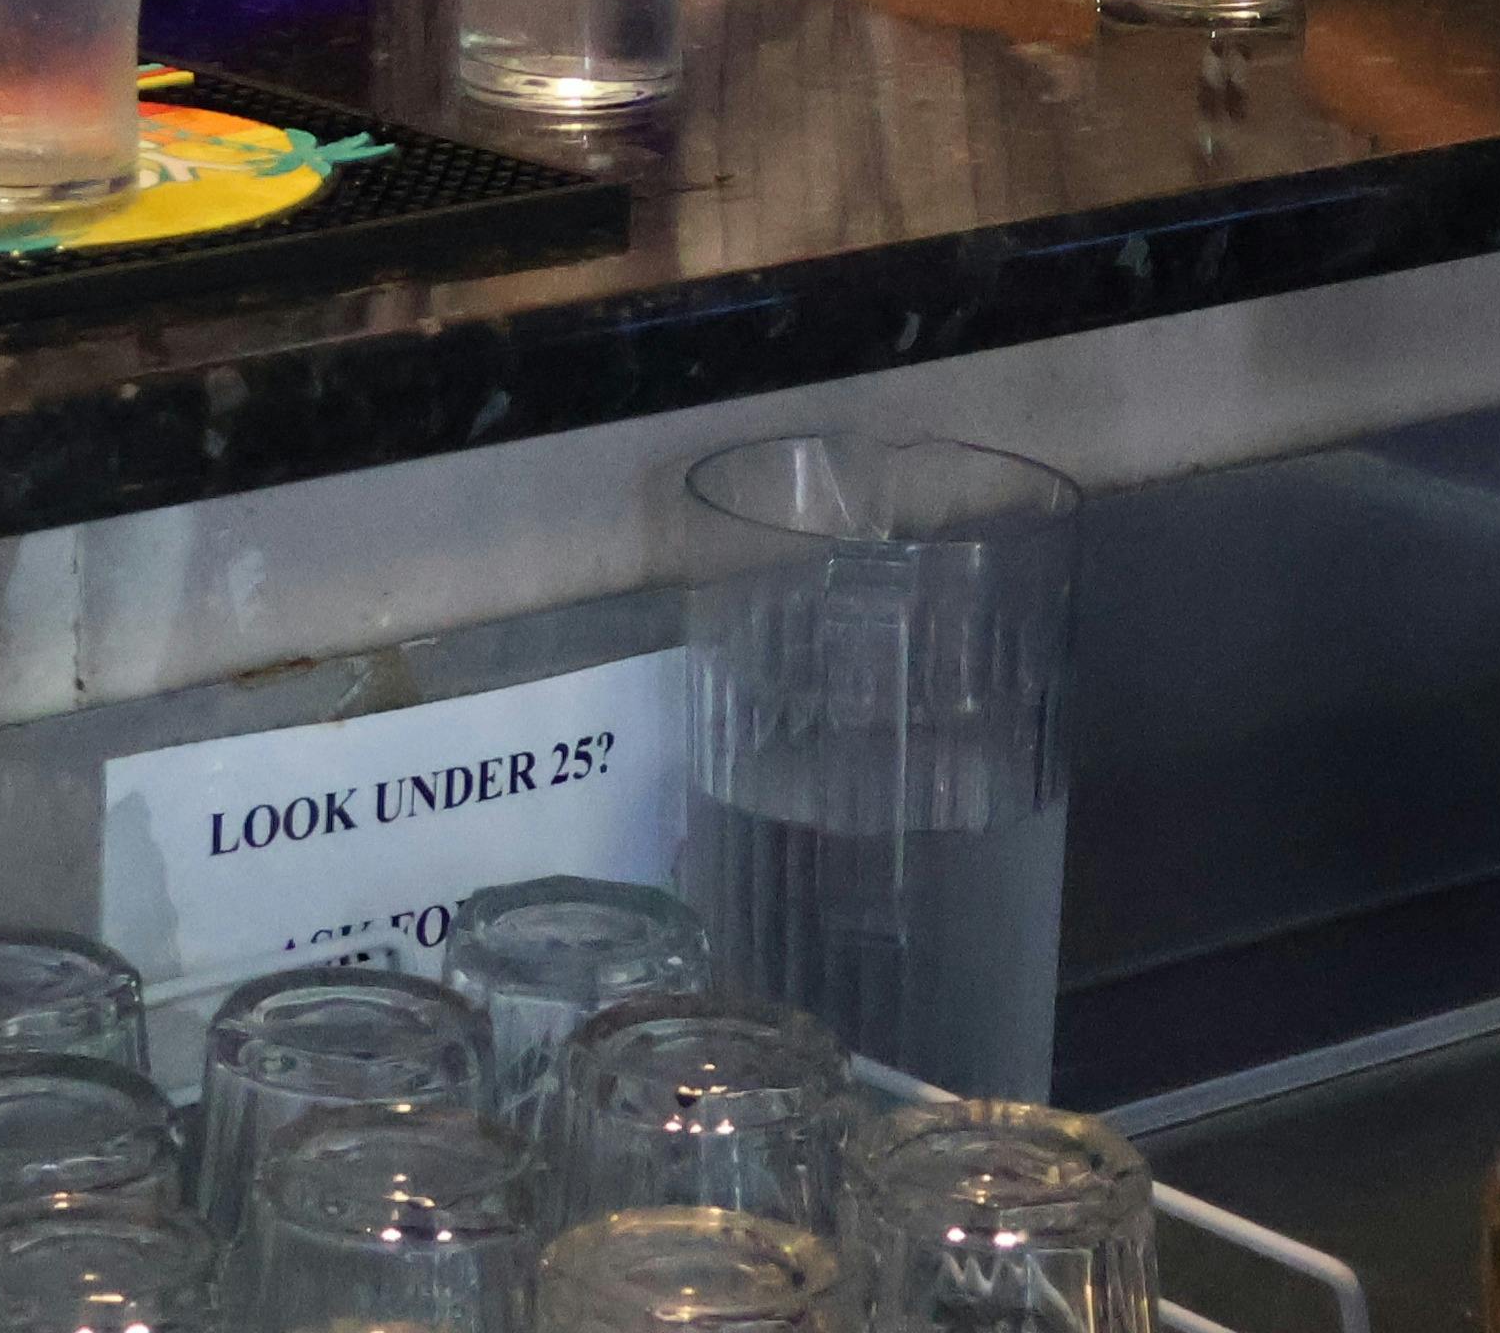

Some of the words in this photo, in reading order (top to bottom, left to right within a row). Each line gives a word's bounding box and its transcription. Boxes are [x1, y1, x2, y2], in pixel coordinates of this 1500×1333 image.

[208, 786, 360, 856] LOOK
[374, 749, 537, 824] UNDER
[551, 730, 616, 786] 25?
